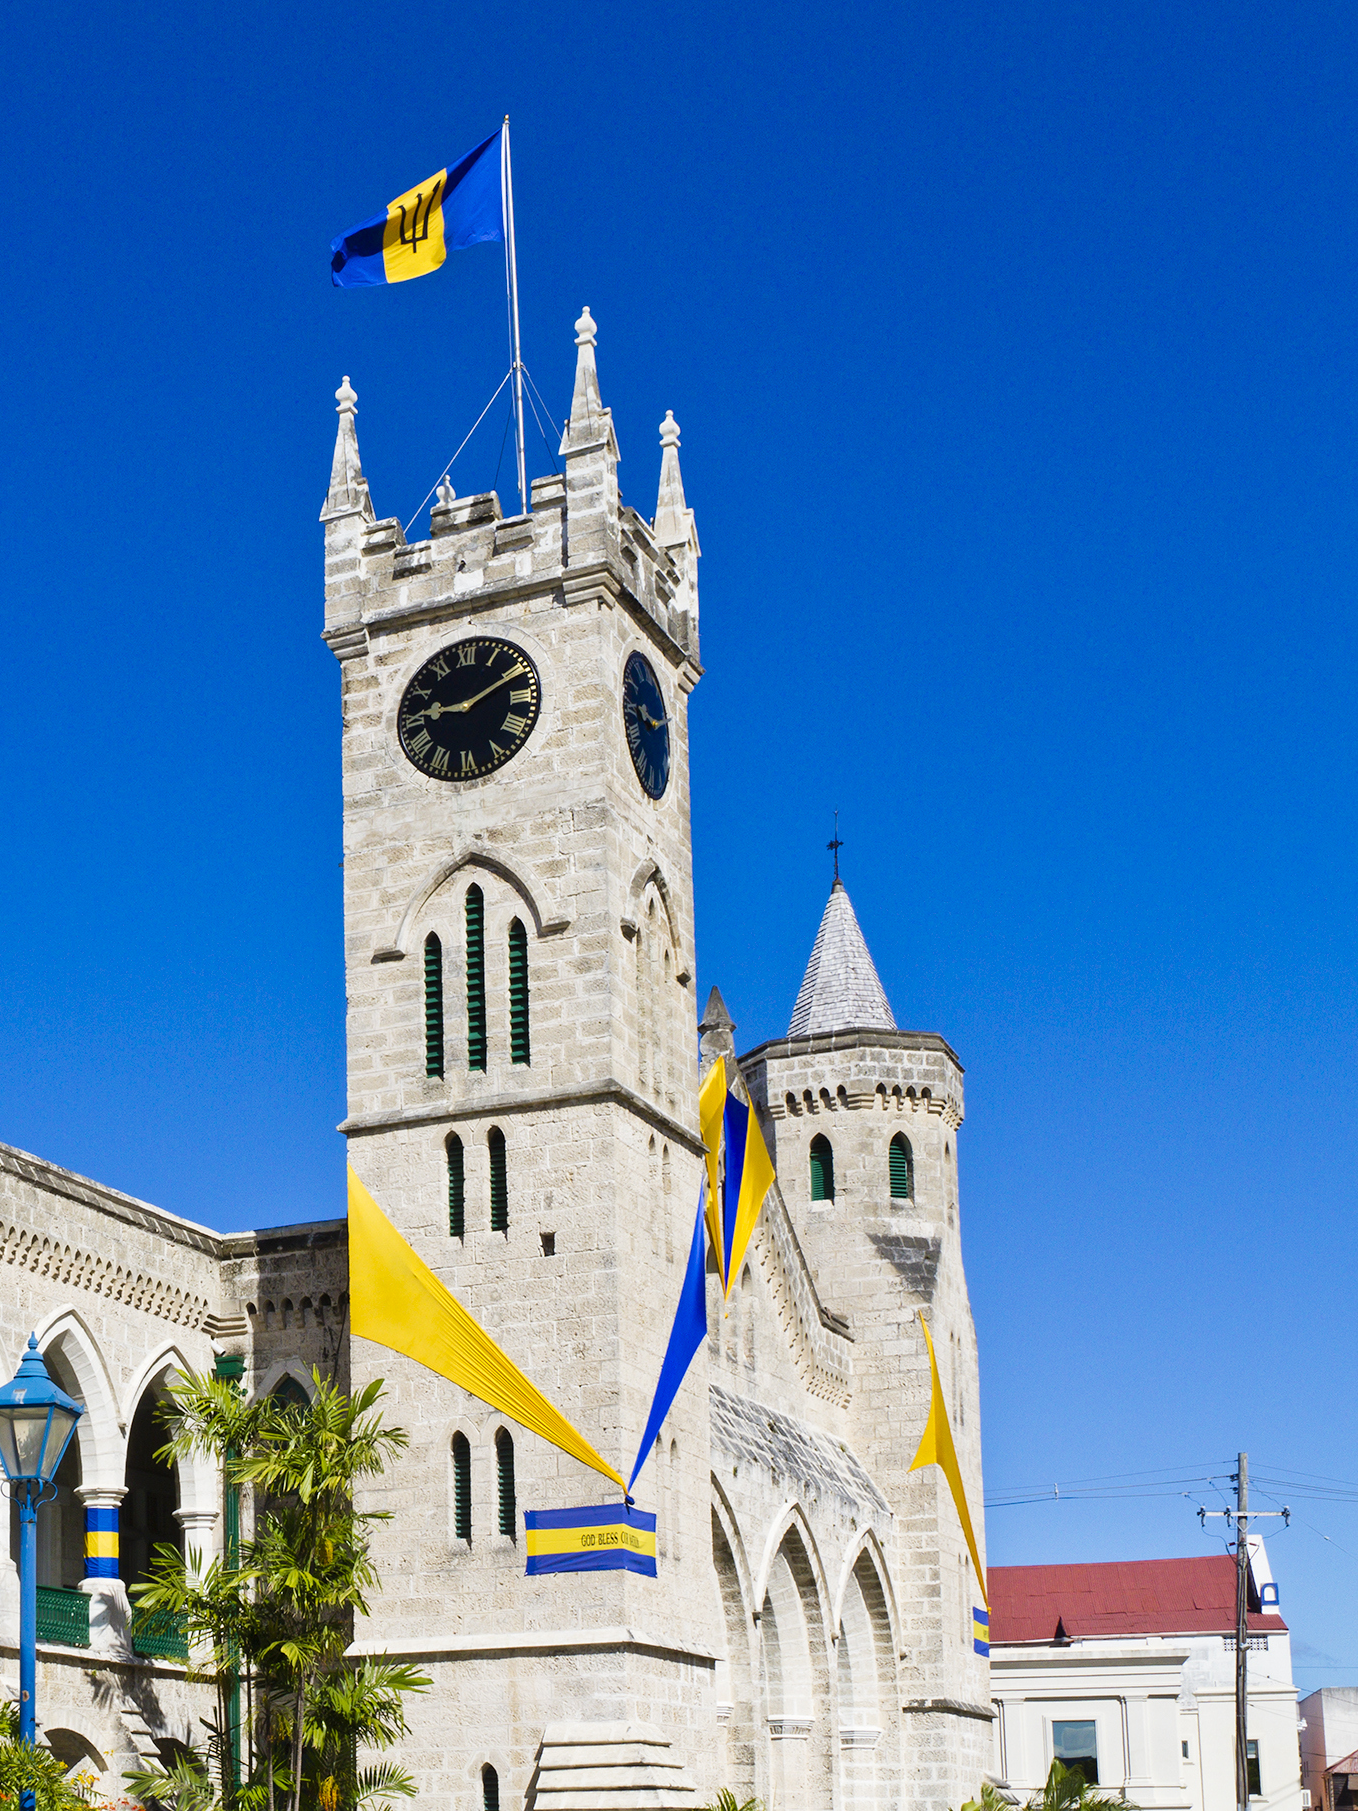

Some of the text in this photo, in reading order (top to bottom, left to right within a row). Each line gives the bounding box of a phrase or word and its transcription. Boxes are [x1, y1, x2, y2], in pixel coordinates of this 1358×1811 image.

[456, 646, 477, 668] XII
[486, 648, 501, 667] I
[430, 656, 451, 681] XI
[412, 685, 432, 700] X
[510, 688, 532, 705] III
[406, 709, 425, 729] IX
[500, 712, 527, 736] IIII
[410, 728, 434, 759] VIII
[489, 740, 505, 758] V
[430, 745, 451, 771] VII
[460, 750, 477, 772] VI
[581, 1534, 596, 1547] GOD
[598, 1532, 619, 1546] BLESS
